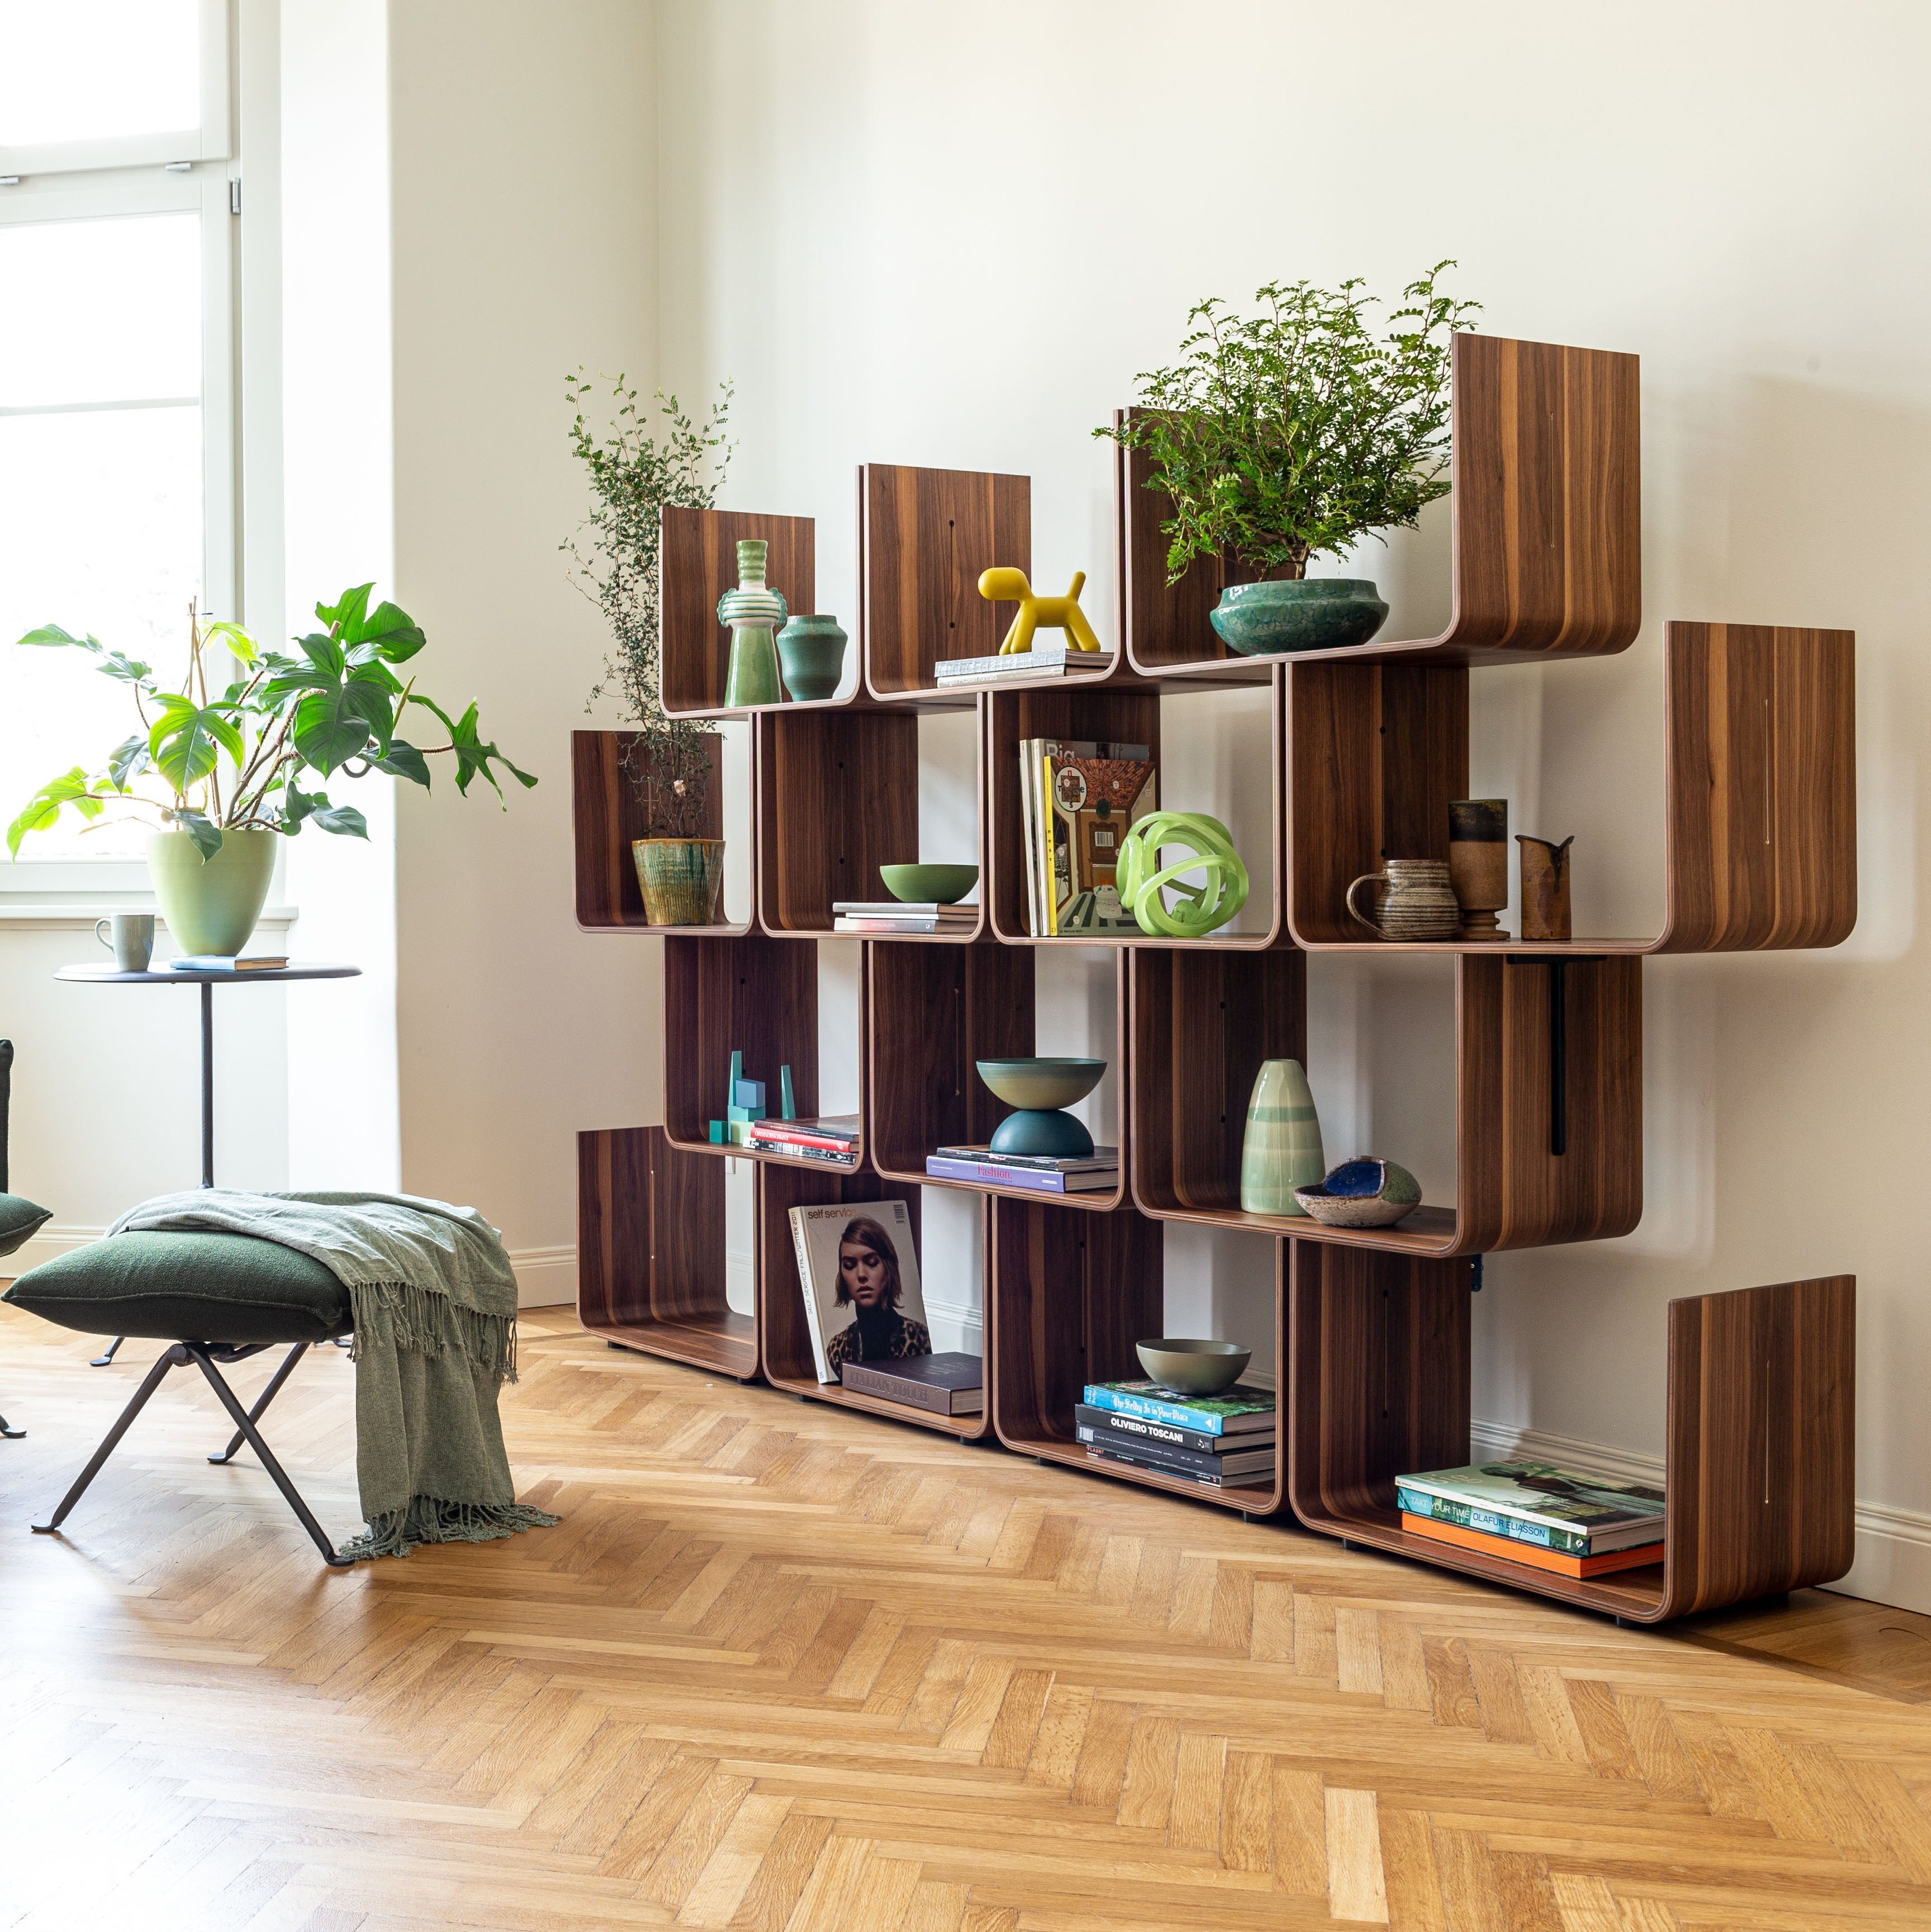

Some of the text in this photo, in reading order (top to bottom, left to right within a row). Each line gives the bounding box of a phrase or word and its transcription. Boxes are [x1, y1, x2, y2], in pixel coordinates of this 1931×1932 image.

[808, 1208, 857, 1219] self service
[801, 1271, 810, 1297] SERVICE
[1112, 1395, 1124, 1409] The
[1125, 1398, 1142, 1414] Selby
[1151, 1405, 1157, 1415] in
[1157, 1405, 1173, 1419] Your
[1173, 1409, 1189, 1422] Place
[1111, 1417, 1183, 1443] OLIVIERO TOSCANI
[1411, 1496, 1429, 1508] TAKE
[1430, 1502, 1451, 1514] YOUR
[1452, 1507, 1470, 1519] TIME
[1473, 1512, 1505, 1528] OLAFUR
[1506, 1521, 1545, 1538] ELIASSON
